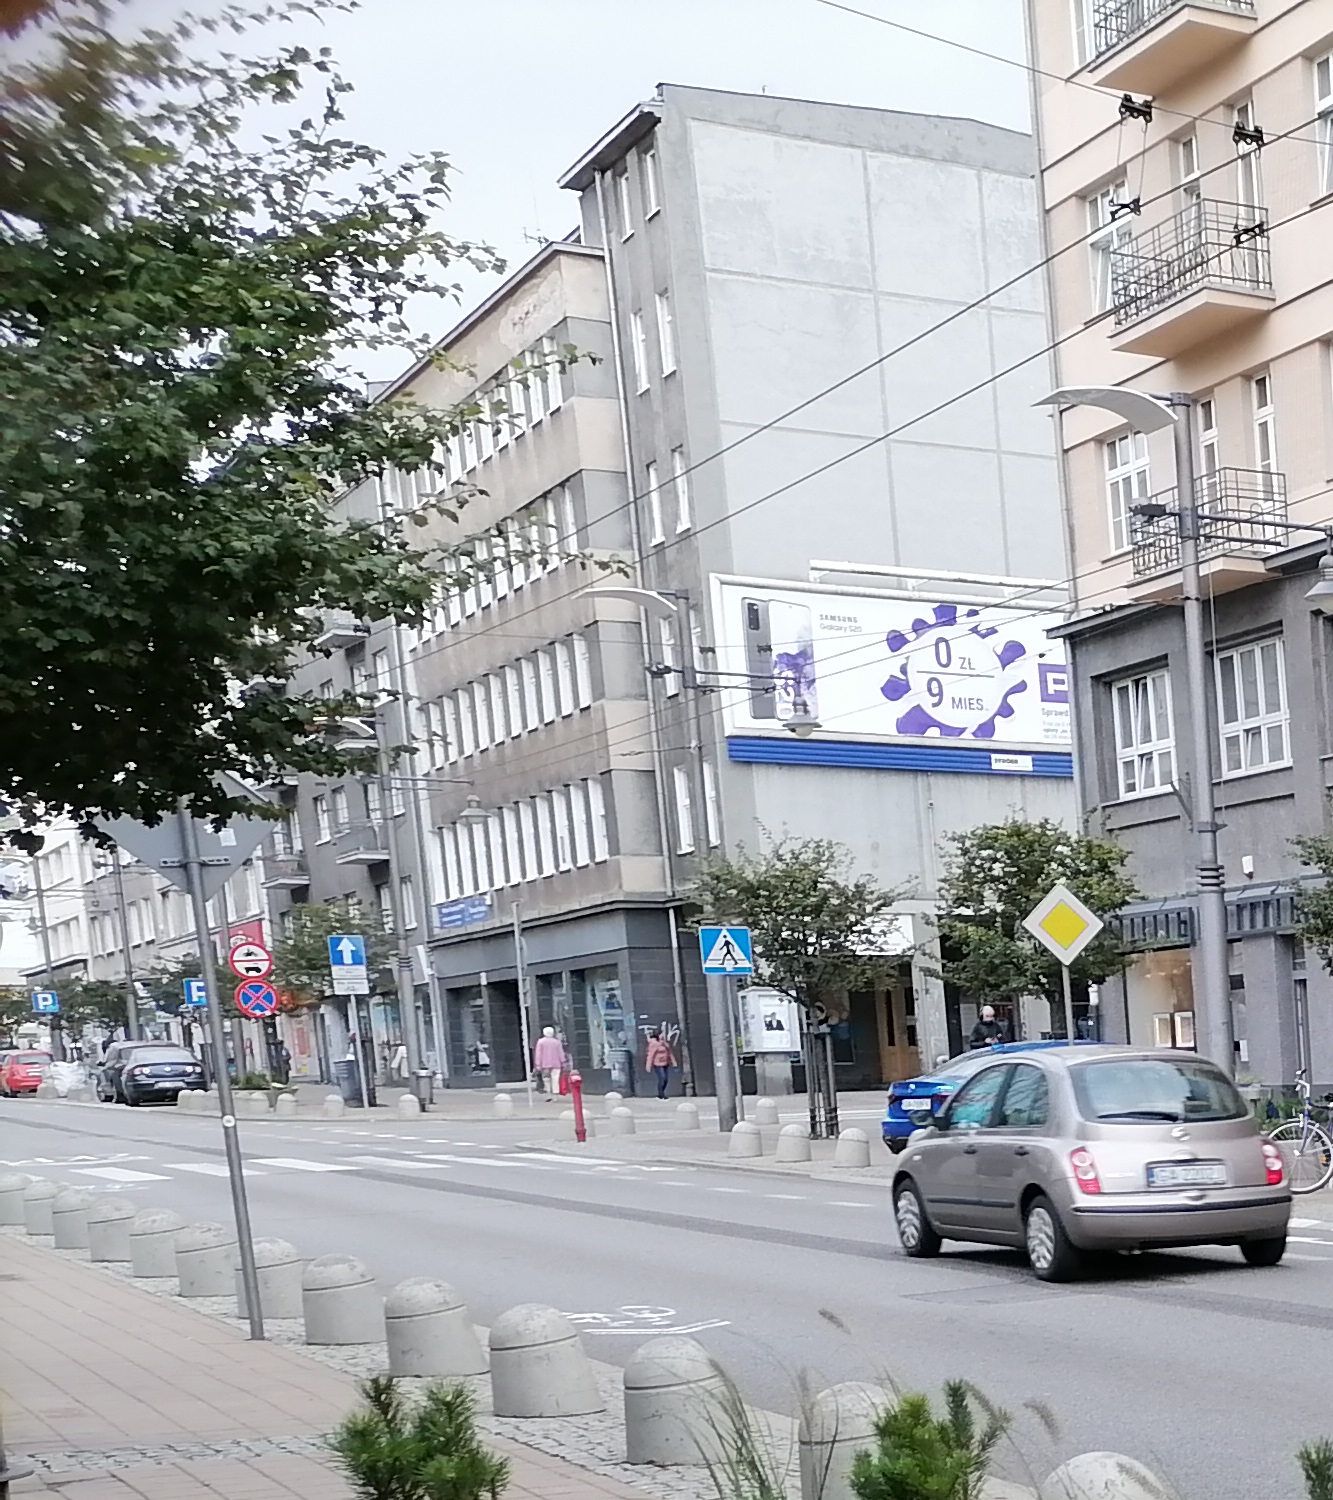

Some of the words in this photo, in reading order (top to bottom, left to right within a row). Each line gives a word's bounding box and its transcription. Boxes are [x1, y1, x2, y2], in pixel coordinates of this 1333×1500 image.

[819, 613, 858, 624] SAMSUNG
[819, 623, 848, 633] Galaxy
[934, 637, 952, 668] 0
[958, 657, 976, 671] ZŁ
[926, 676, 944, 708] 9
[37, 993, 53, 1011] P
